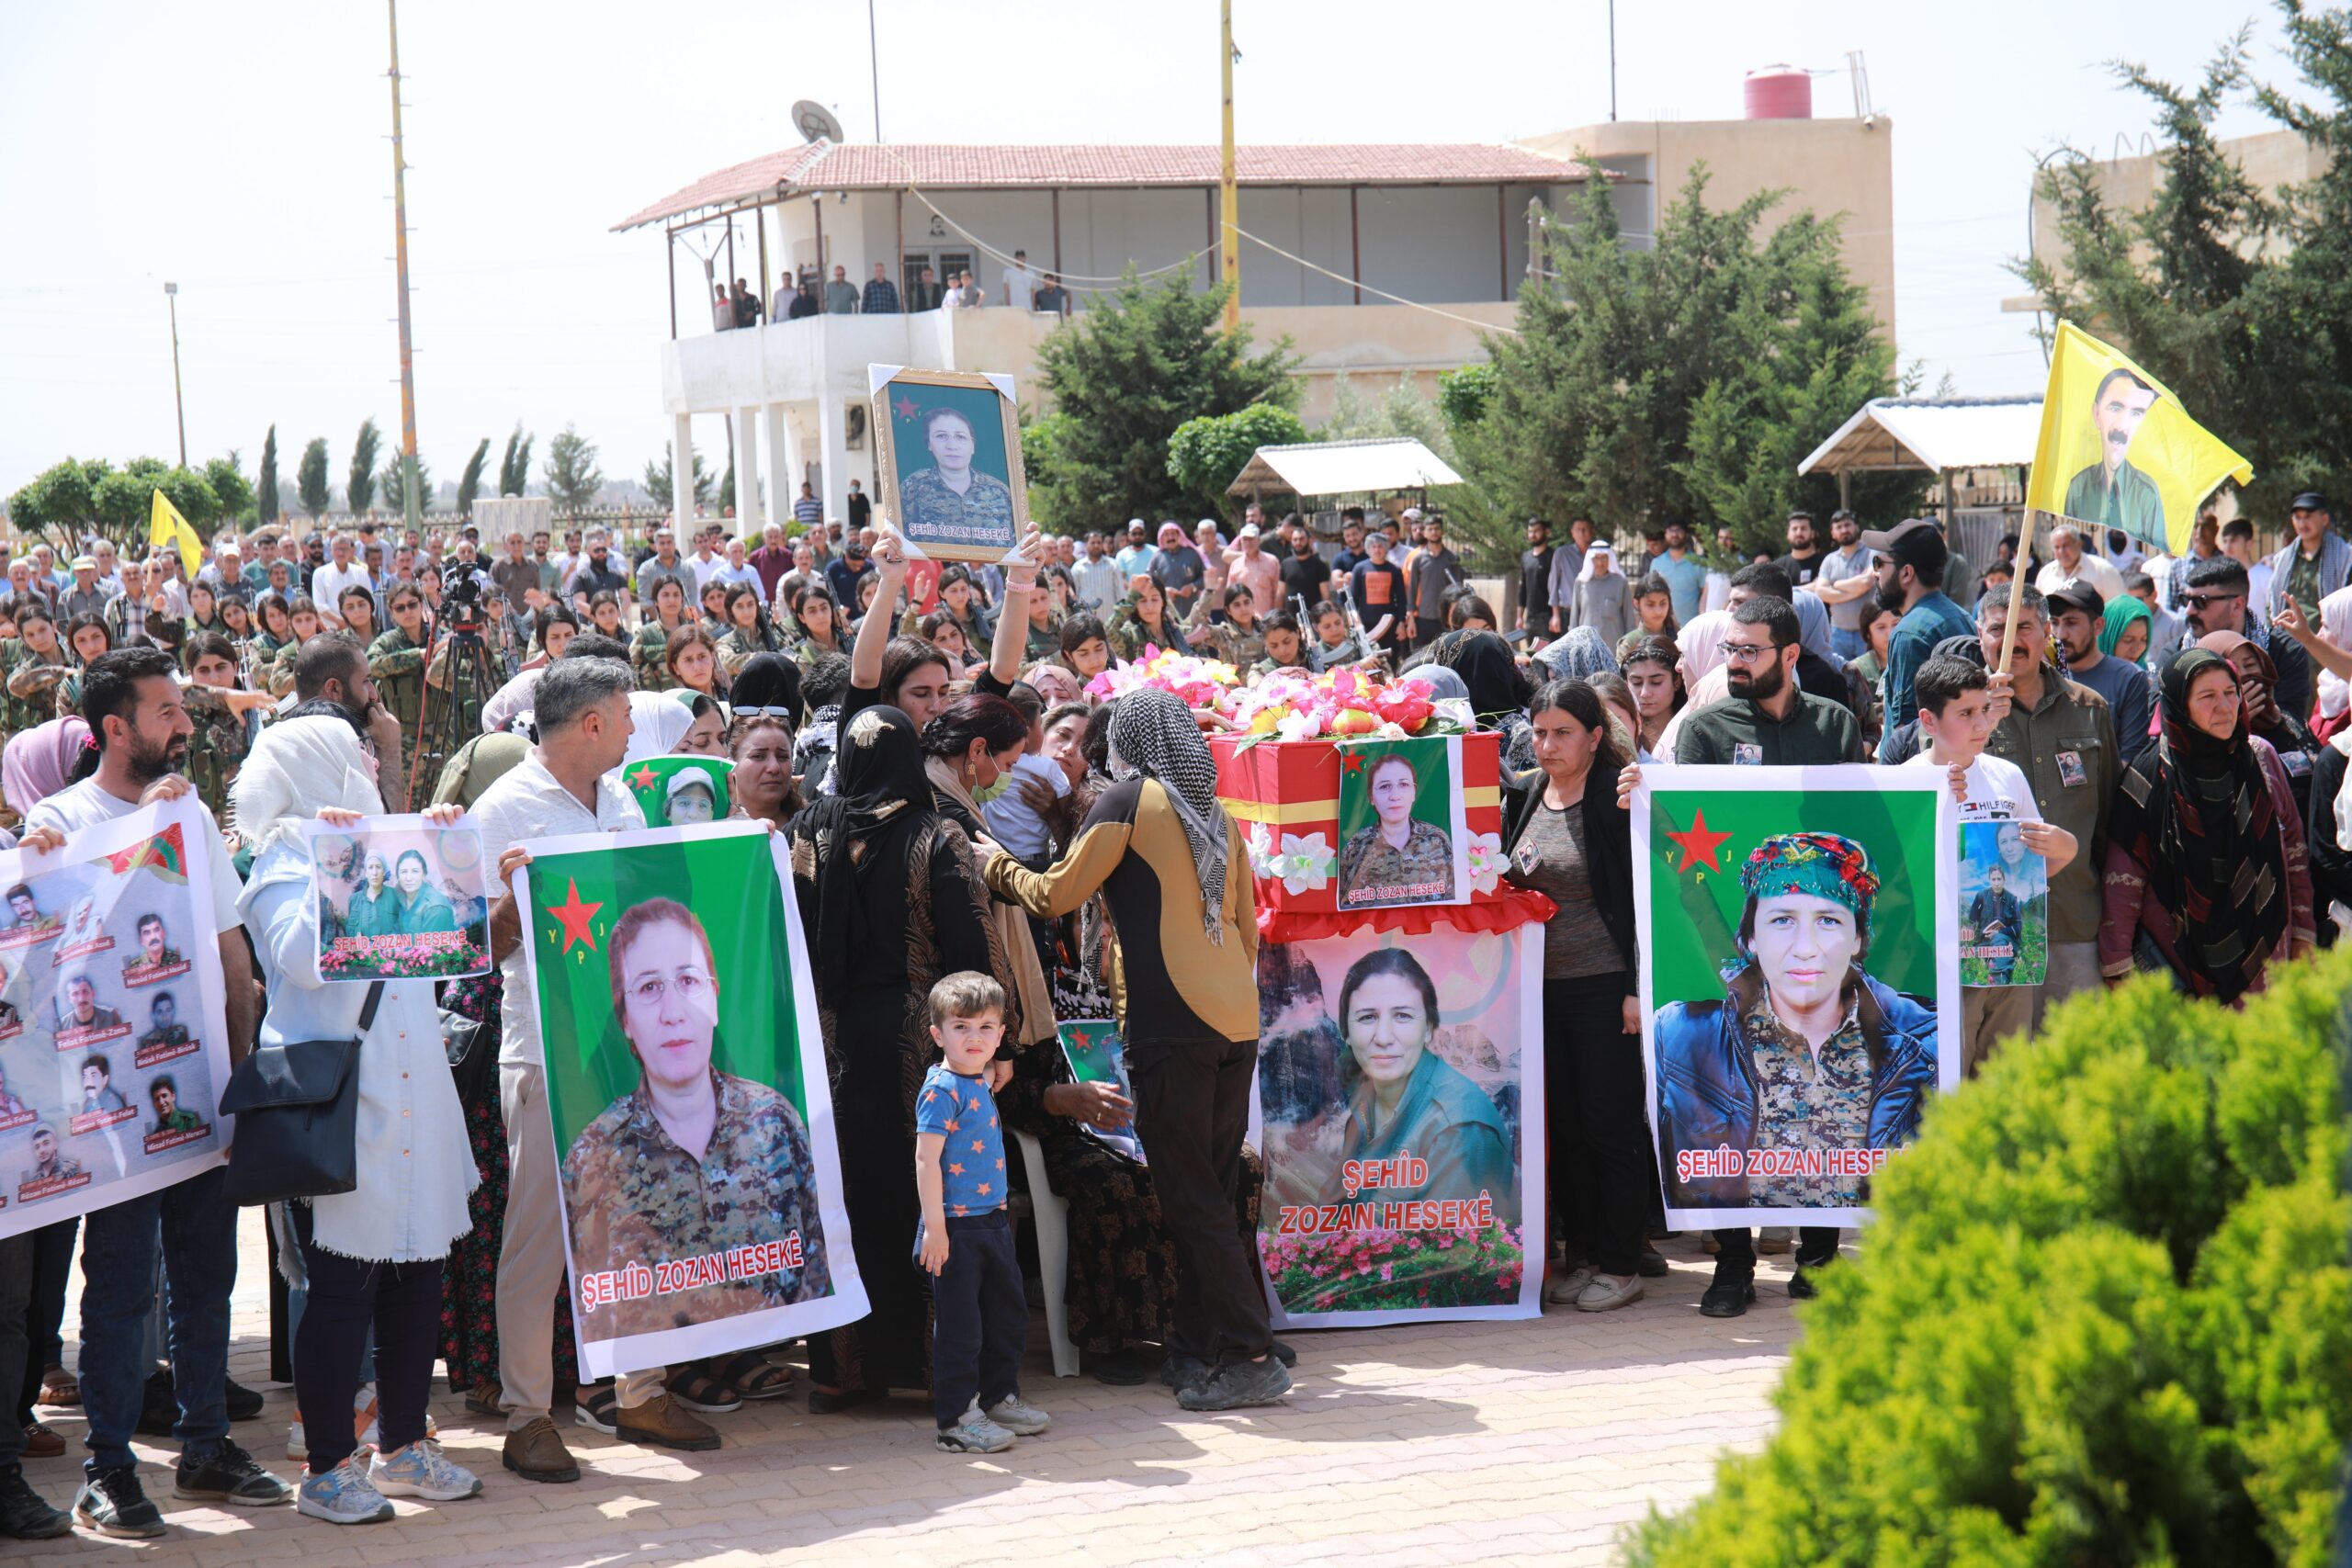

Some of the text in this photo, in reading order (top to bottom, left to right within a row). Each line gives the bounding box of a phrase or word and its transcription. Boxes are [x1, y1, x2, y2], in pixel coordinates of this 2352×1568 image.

[909, 522, 1011, 540] ŞEHÎD ZOZAN HESEKÊ
[1978, 800, 2016, 811] HILFIGER
[1665, 850, 1732, 884] Y P J
[1349, 879, 1445, 904] ŞEHÎD ZOZAN HESEKÊ
[371, 933, 413, 950] ZOZAN
[548, 922, 605, 964] Y P J
[1342, 1150, 1429, 1199] ŞEHÎD
[1677, 1143, 1907, 1182] ŞEHÎD ZOZAN HESE
[1278, 1190, 1492, 1235] ZOZAN HESEKÊ
[581, 1230, 804, 1313] ŞEHÎD ZOZAN HESEKÊ
